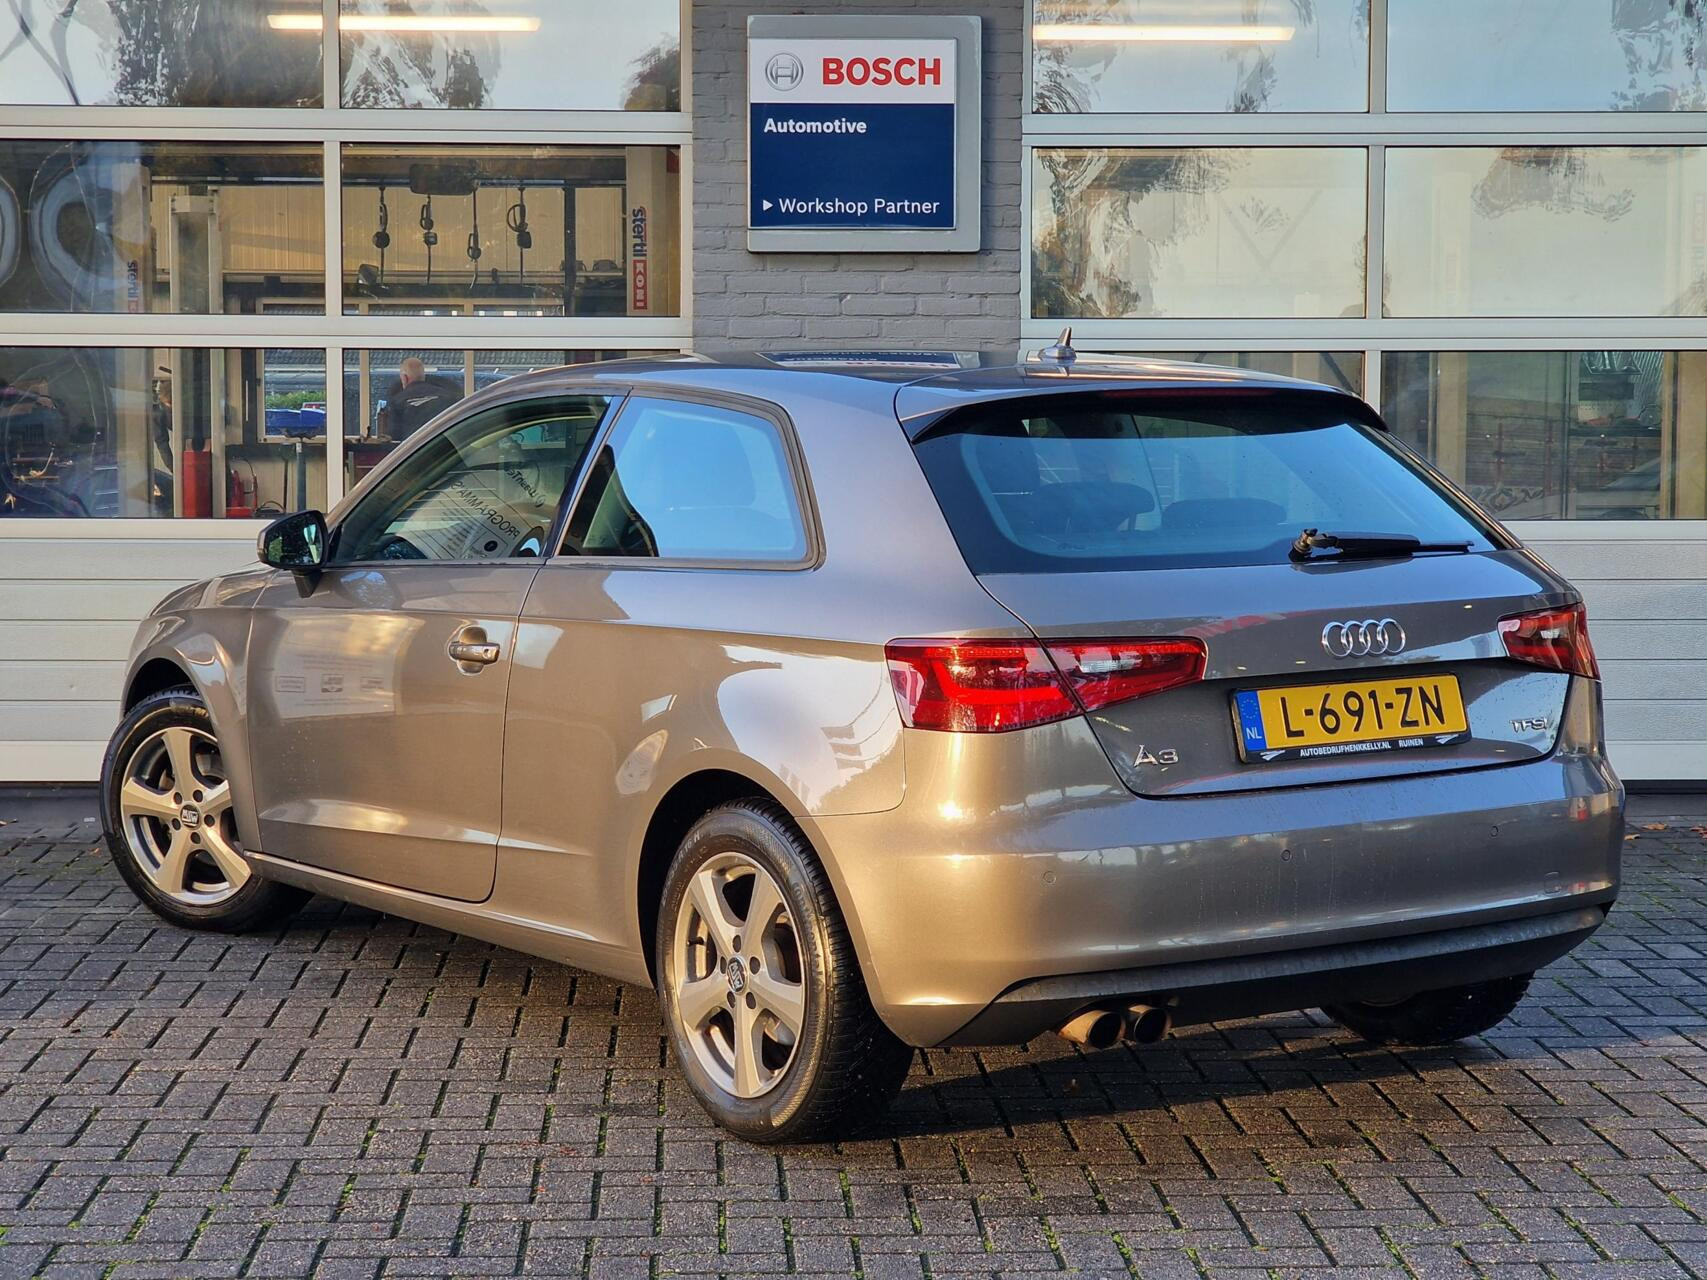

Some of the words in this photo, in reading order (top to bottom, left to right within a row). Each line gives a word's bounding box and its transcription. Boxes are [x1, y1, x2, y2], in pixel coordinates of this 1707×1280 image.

[822, 57, 941, 86] BOSCH
[763, 118, 868, 134] Automotive
[778, 198, 869, 216] Workshop
[874, 198, 940, 214] Partner
[632, 208, 647, 257] stertil
[635, 262, 646, 307] KONI
[1279, 685, 1446, 739] L-691-ZN
[1246, 728, 1263, 740] NL
[1398, 737, 1424, 748] RUINEN
[1133, 744, 1179, 767] A3
